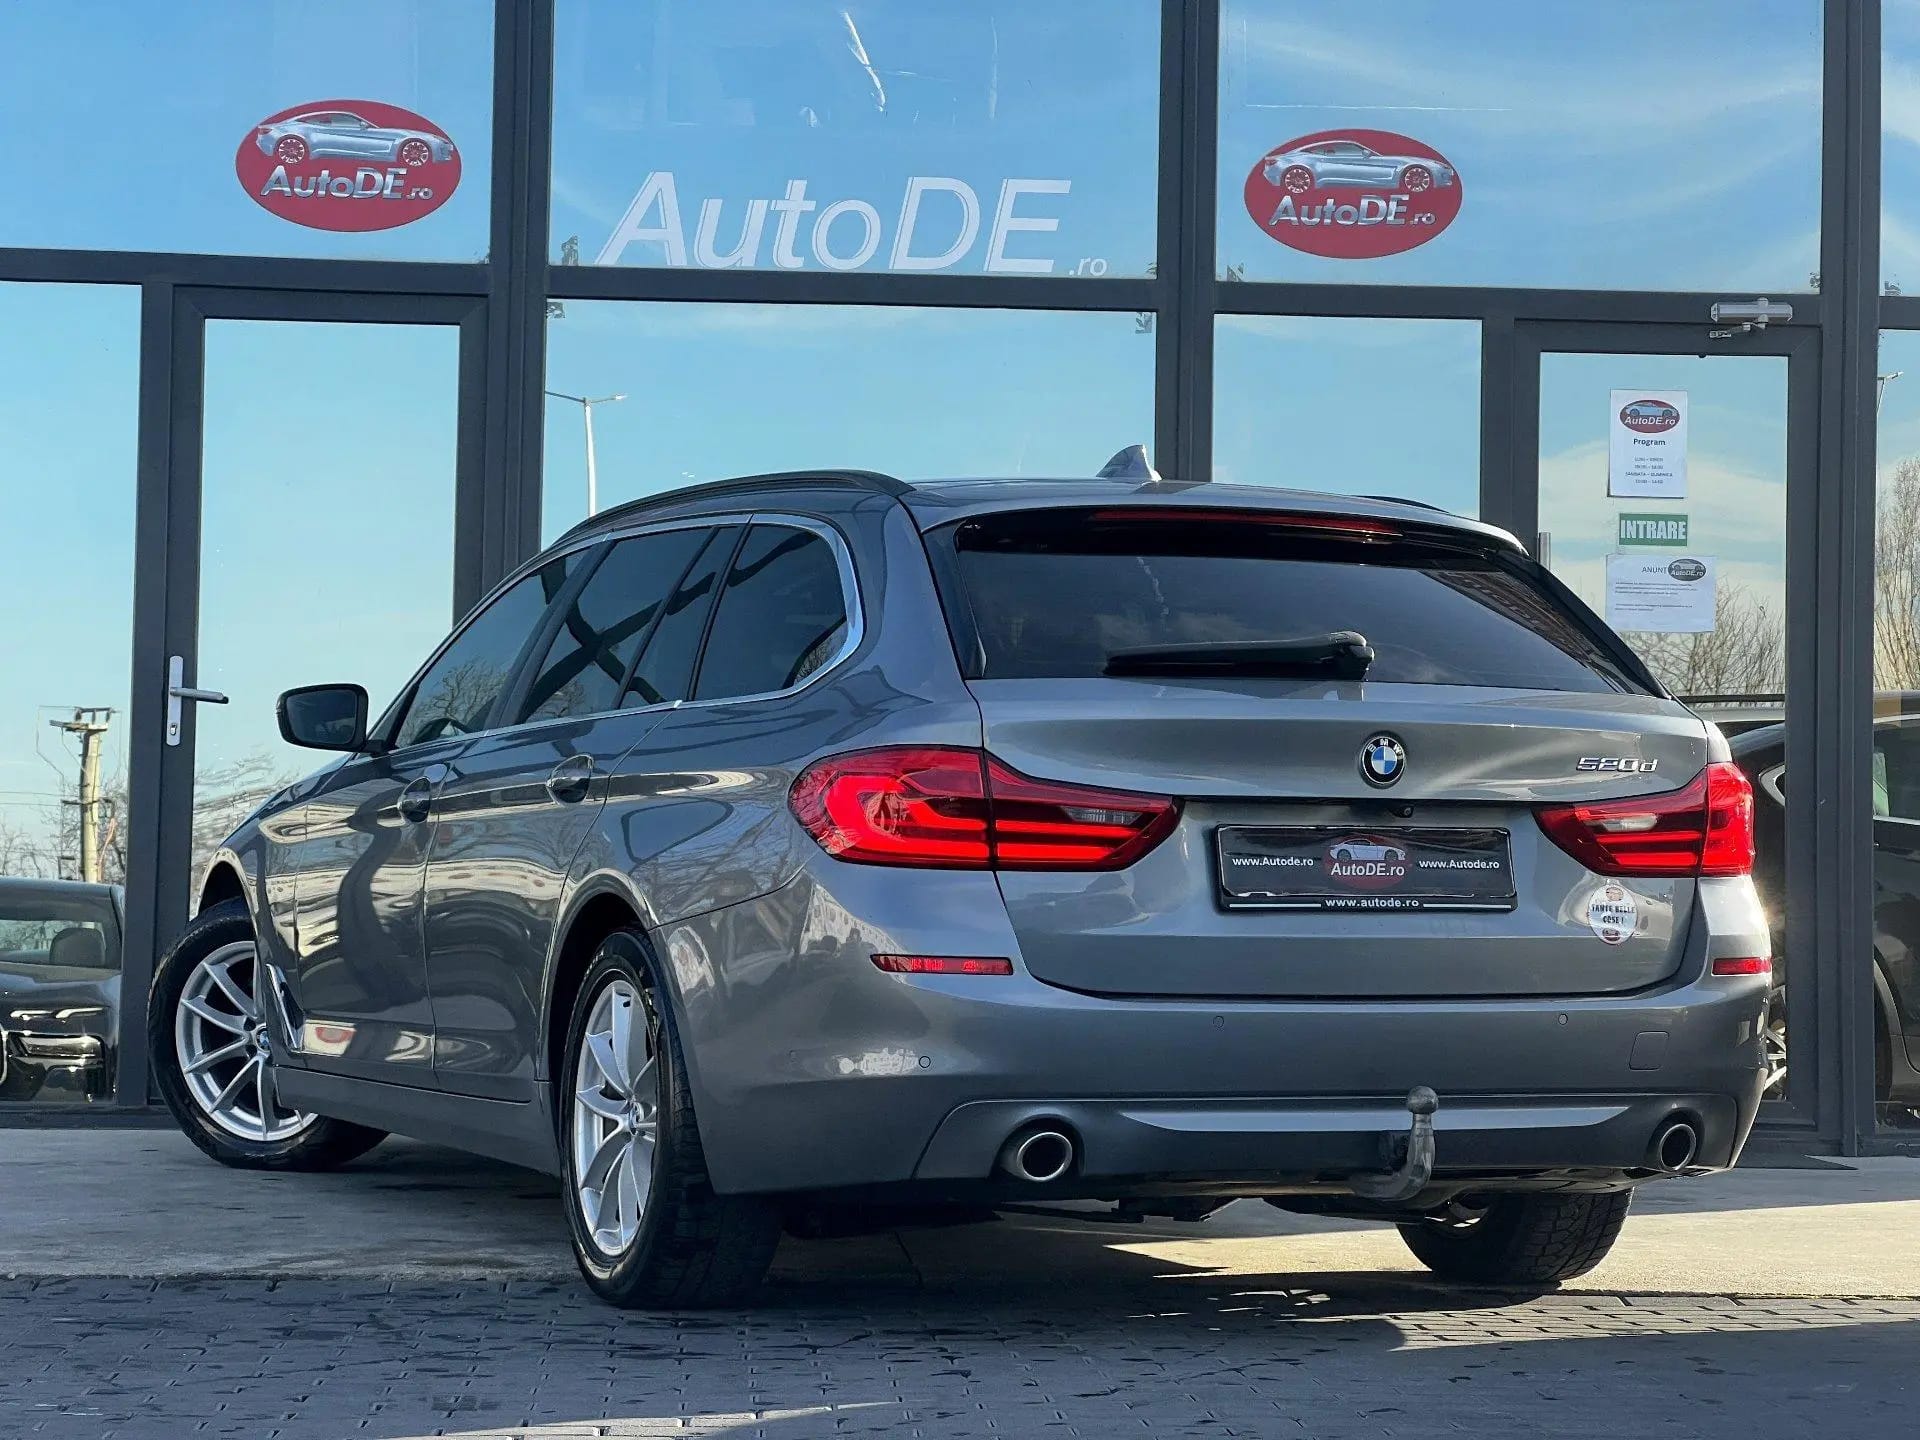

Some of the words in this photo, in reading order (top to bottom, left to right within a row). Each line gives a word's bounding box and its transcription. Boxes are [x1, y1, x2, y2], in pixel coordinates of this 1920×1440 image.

[1624, 416, 1676, 426] AutoDE.ro
[1633, 438, 1666, 447] Program
[1620, 520, 1687, 540] INTRARE
[1367, 738, 1403, 760] BMW
[1576, 757, 1659, 773] 520d
[1232, 856, 1314, 868] www.Autode.ro
[1418, 858, 1500, 870] www.Autode.ro
[1330, 862, 1405, 877] AutoDE.ro
[1325, 897, 1419, 909] www.autode.ro
